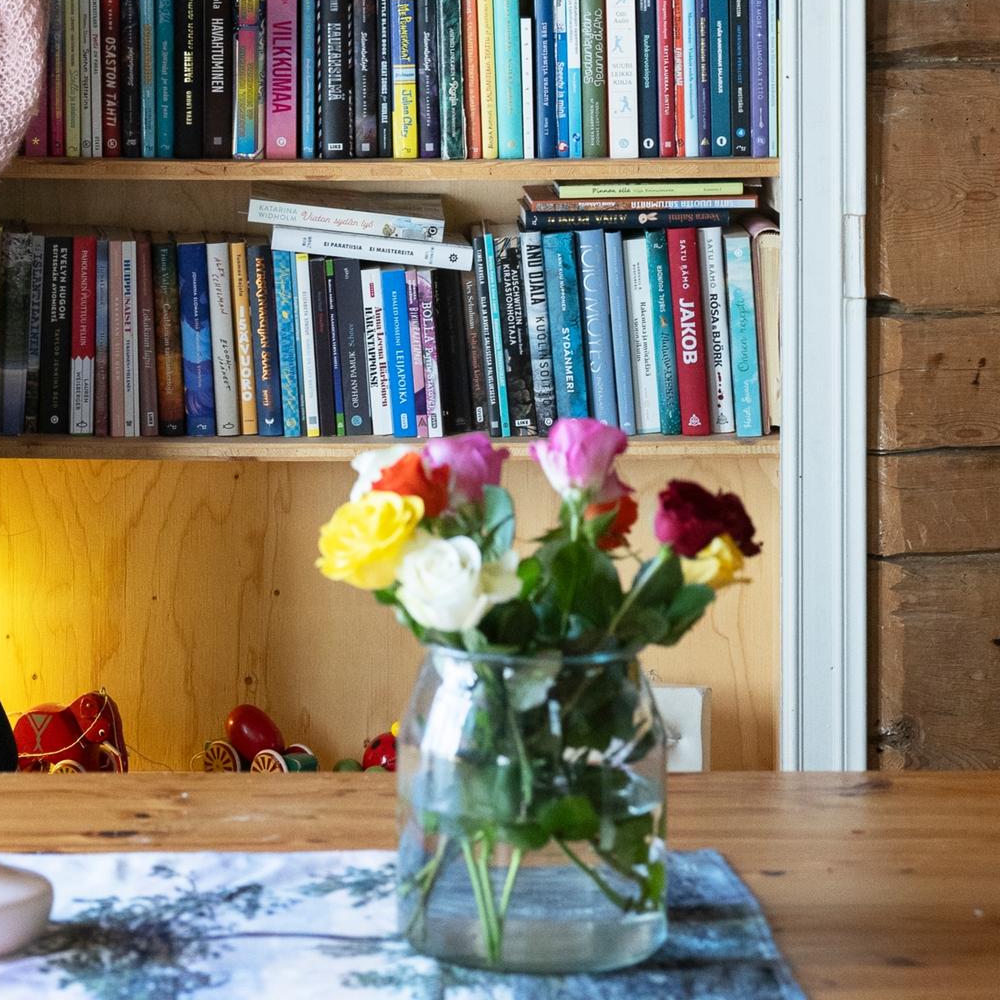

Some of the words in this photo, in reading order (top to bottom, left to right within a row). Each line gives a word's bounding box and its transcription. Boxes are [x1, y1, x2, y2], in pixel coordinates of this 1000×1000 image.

[105, 37, 116, 88] OSASTON
[211, 18, 224, 93] HAVAHTUMINEN
[328, 22, 344, 101] HAUKANSILMÄ
[583, 10, 594, 85] Sodankylän
[594, 42, 605, 86] Jeanne
[184, 51, 194, 83] PAKENE
[272, 20, 292, 113] VILKKUMAA
[556, 62, 564, 88] Speedy
[105, 93, 117, 127] TÄHTI
[401, 90, 412, 115] Julian
[401, 116, 412, 138] Clary
[51, 244, 59, 281] SEITSEMÄN
[331, 242, 362, 251] PARATIISIA
[376, 247, 414, 256] MAISTEREITA
[526, 244, 542, 267] ANU
[679, 240, 687, 261] SATU
[59, 248, 67, 282] EVELYN
[80, 250, 88, 291] PAHOLAINEN
[657, 265, 665, 292] POUNDER
[680, 264, 689, 289] RÄMÖ
[709, 264, 717, 289] RÄMÖ
[123, 260, 132, 333] HUIPPUNAISET
[465, 280, 473, 294] Alex
[511, 269, 522, 325] AUSCHWITZIN
[529, 271, 545, 305] OJALA
[30, 253, 42, 356] ISLANTILAINEN
[375, 306, 383, 330] Anna
[467, 296, 476, 329] Schulman
[503, 264, 516, 345] KIRJASTONHOITAJA
[640, 301, 649, 334] Rakentava
[710, 293, 720, 325] RÓSA
[142, 308, 151, 347] Lokakuun
[422, 301, 436, 344] BOLLA
[679, 298, 697, 365] JAKOB
[142, 349, 152, 368] lapsi
[349, 351, 358, 378] PAMUK
[364, 307, 378, 388] HÄRÄNTAPPOASE
[561, 327, 574, 393] SYDÄNMERI
[712, 331, 723, 368] BJÖRK
[351, 380, 359, 408] ORHAN
[378, 362, 389, 407] Härkönen
[395, 350, 407, 404] LEIJAPOIKA
